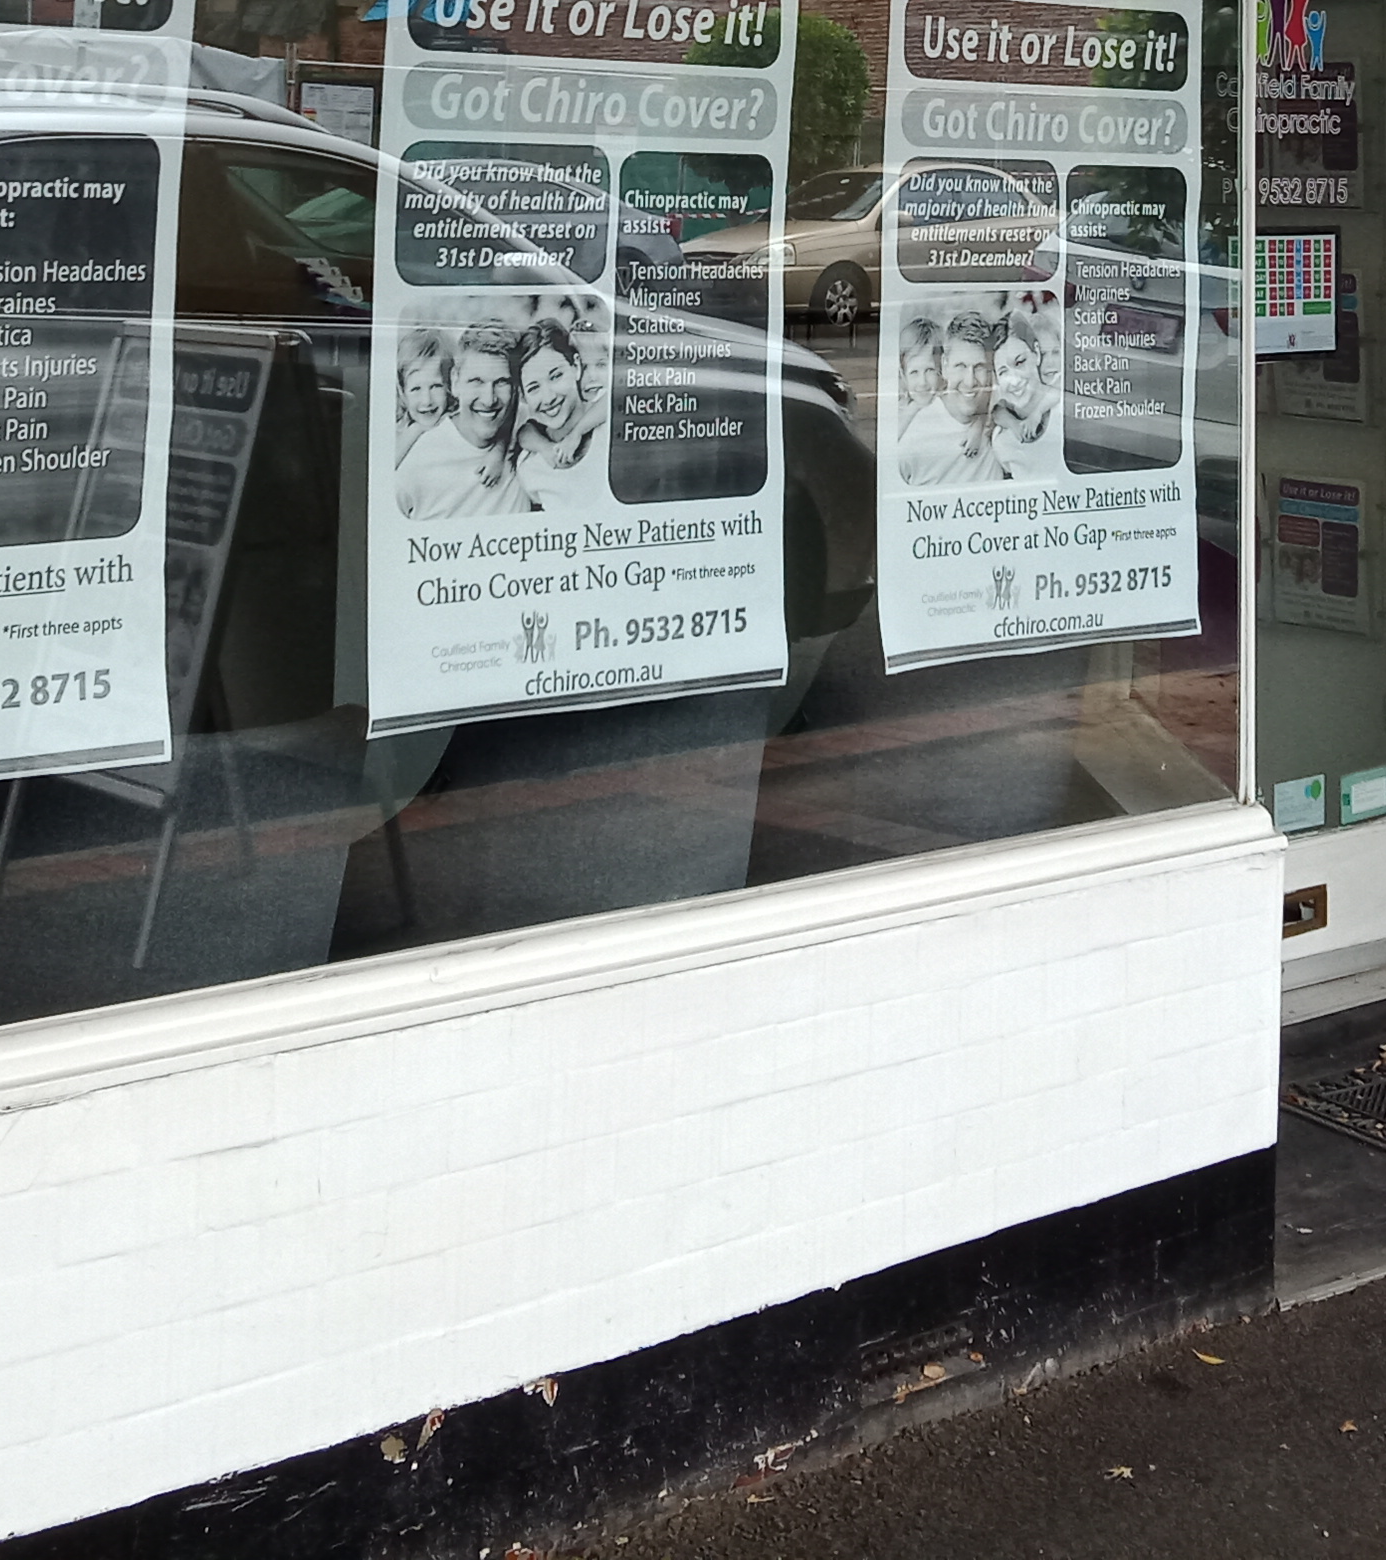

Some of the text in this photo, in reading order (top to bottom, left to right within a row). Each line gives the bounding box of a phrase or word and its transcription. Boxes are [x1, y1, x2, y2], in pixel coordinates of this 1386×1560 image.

[922, 15, 1178, 72] Use it or Lose it!
[431, 73, 509, 122] Got
[519, 77, 626, 127] Chiro
[638, 83, 765, 130] Cover?
[1300, 74, 1356, 106] Family
[923, 98, 1176, 145] Got Chiro Cover?
[1226, 106, 1341, 139] Ciropractic
[413, 162, 601, 186] Did you know that the
[82, 181, 125, 205] may
[405, 192, 605, 214] majority of health fund
[624, 191, 747, 213] Chiropractic may
[1258, 177, 1302, 204] 9532
[1305, 177, 1348, 204] 8715
[413, 219, 596, 239] entitlements reset on
[623, 218, 671, 234] assist:
[435, 247, 574, 267] 31st December?
[43, 262, 146, 284] Headaches
[629, 261, 764, 280] Tension Headaches
[629, 288, 700, 309] Migraines
[628, 316, 684, 334] Sciatica
[627, 340, 731, 362] Sports Injuries
[23, 354, 97, 380] Injuries
[627, 369, 696, 387] Back Pain
[4, 389, 47, 411] Pain
[625, 395, 696, 414] Neck Pain
[3, 420, 48, 441] Pain
[624, 418, 743, 442] Frozen Shoulder
[21, 446, 110, 473] Shoulder
[907, 482, 1181, 522] Now Accepting New Patients with
[408, 511, 762, 564] Now Accepting New Patients with
[912, 524, 1107, 559] Chiro Cover at No Gap
[73, 554, 133, 588] with
[1035, 565, 1172, 601] Ph. 9532 8715
[417, 562, 666, 606] Chiro Cover at No Gap
[43, 620, 79, 638] three
[82, 616, 123, 639] appts
[575, 607, 747, 651] Ph. 9532 8715
[994, 612, 1104, 638] cfchiro.com.au
[29, 669, 111, 705] 8715
[525, 662, 663, 696] cfchiro.com.au
